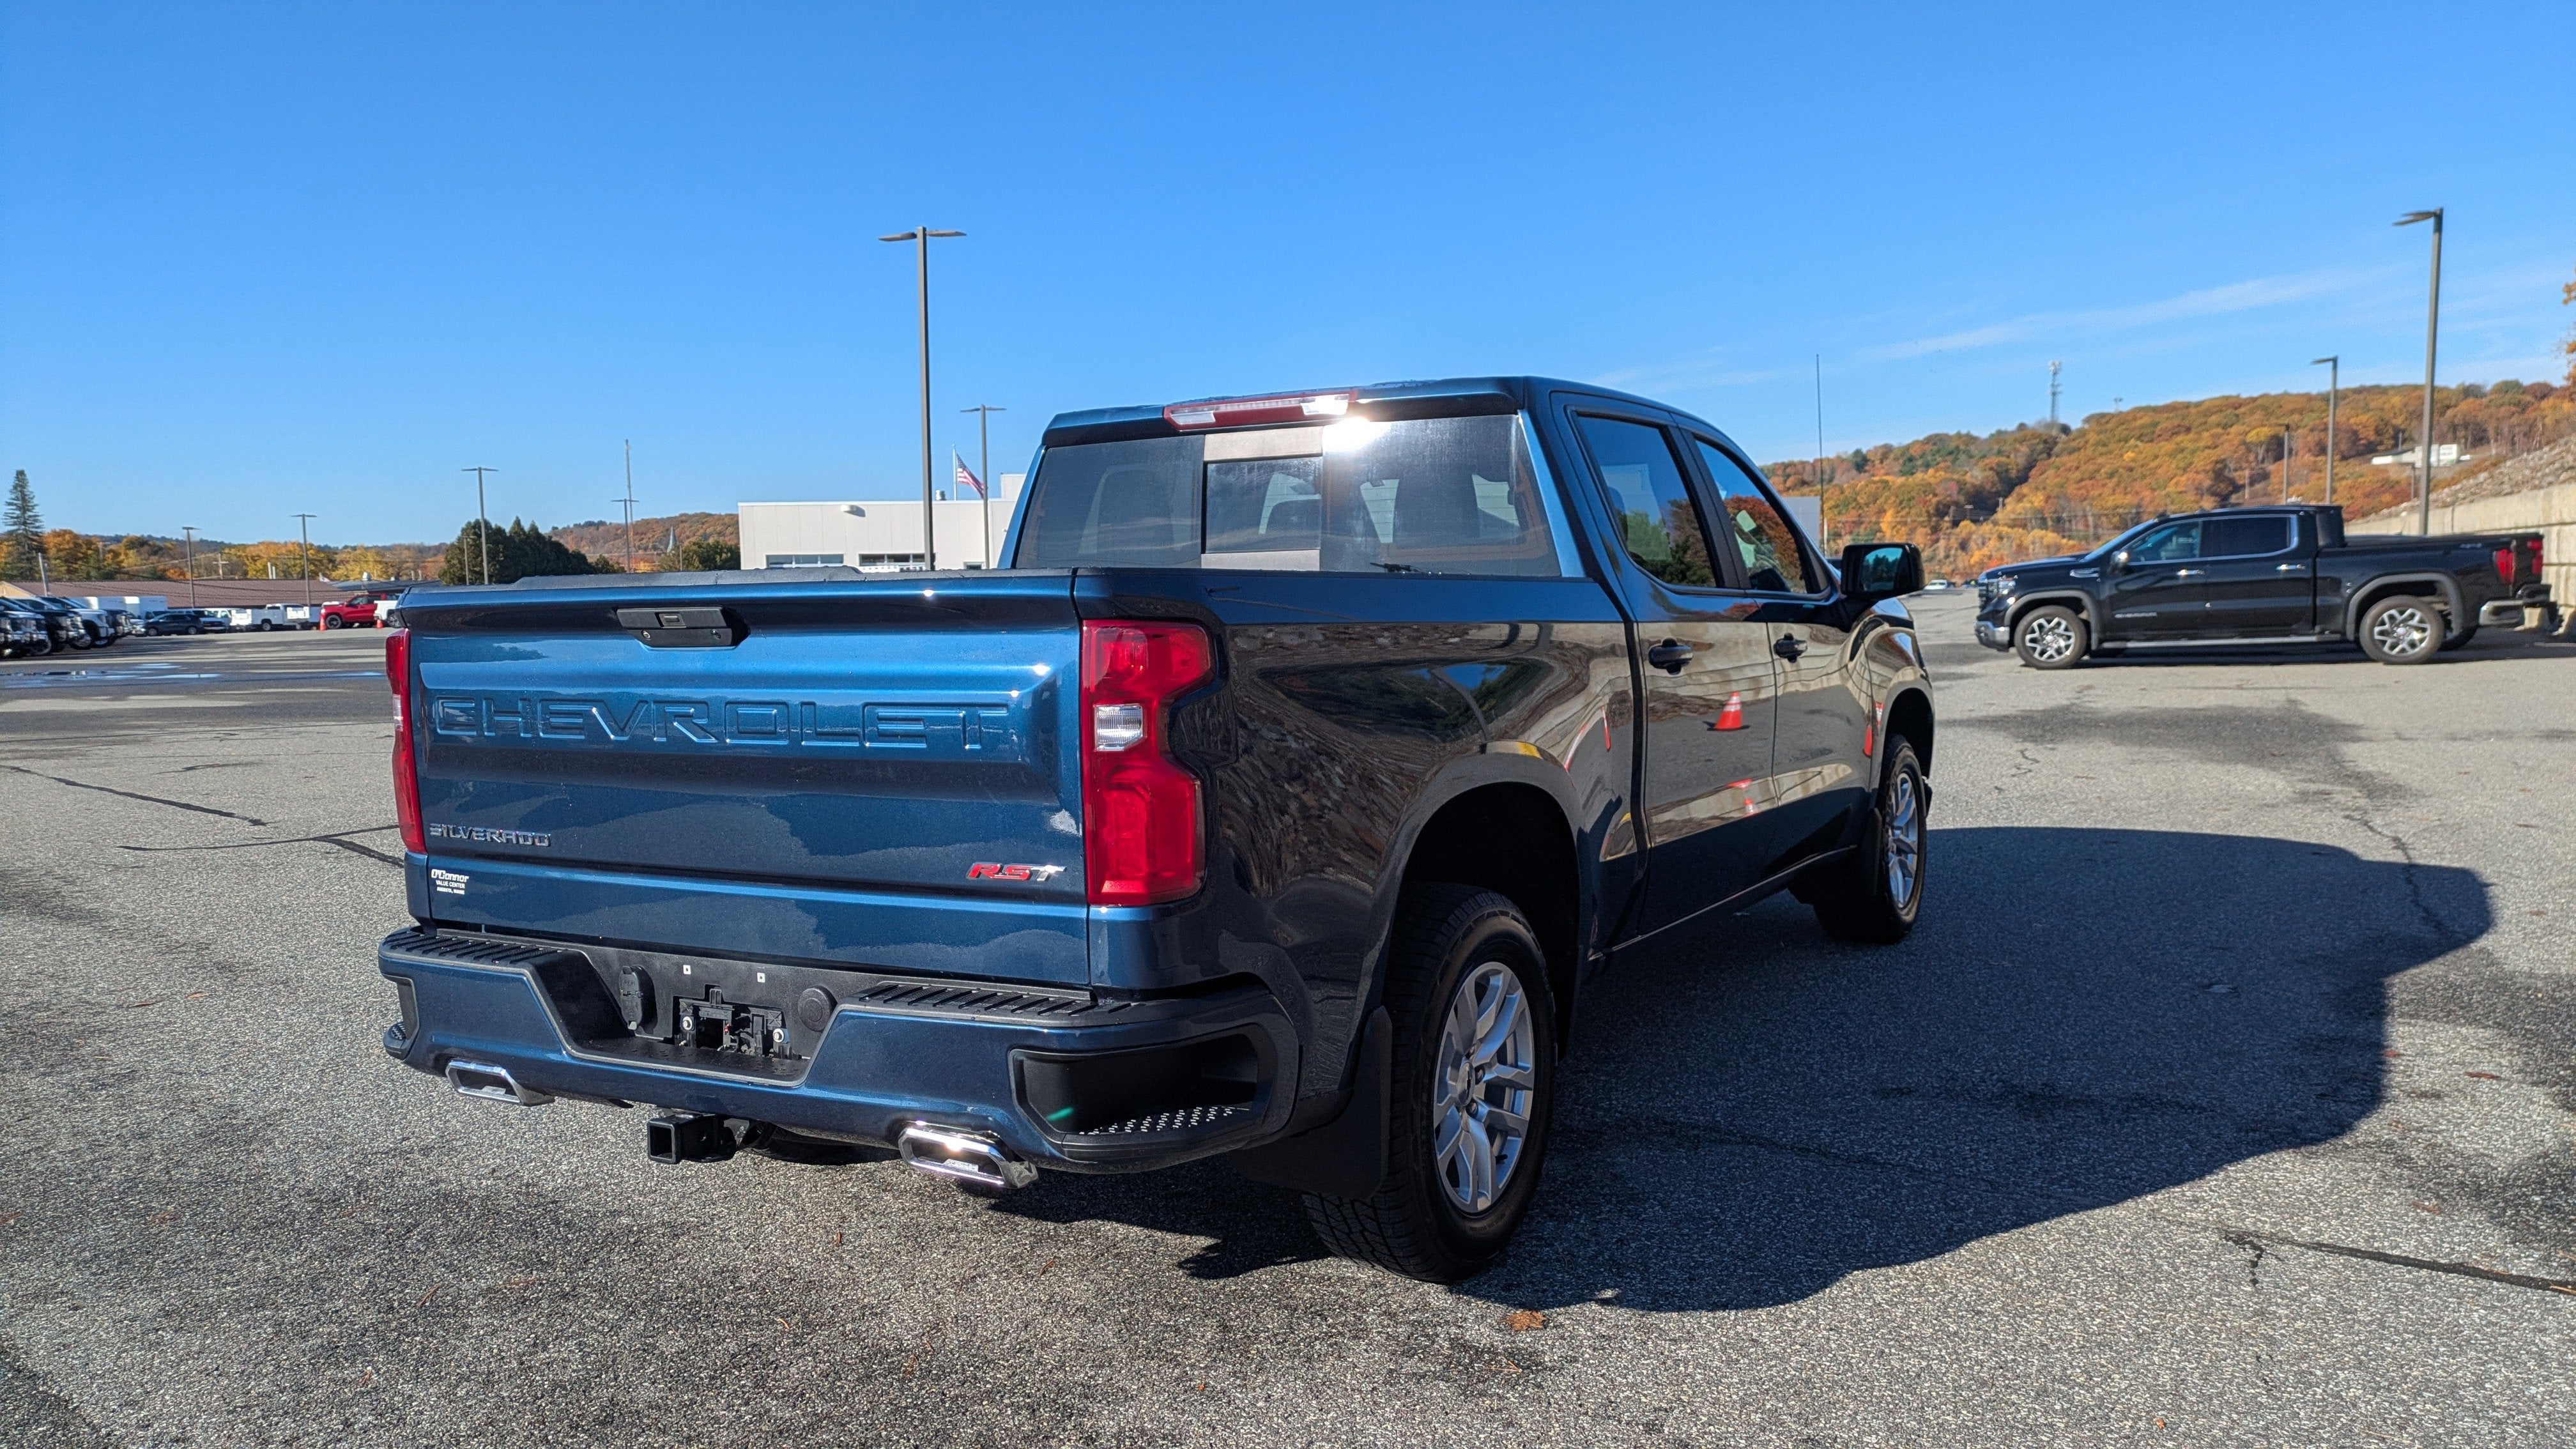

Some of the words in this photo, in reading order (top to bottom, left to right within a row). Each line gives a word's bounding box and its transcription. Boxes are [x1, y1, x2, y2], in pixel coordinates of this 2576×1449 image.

[436, 695, 1009, 750] CHEVROLET
[429, 823, 552, 847] SILVERADO
[431, 868, 470, 882] O'Connor
[965, 861, 1068, 882] RST
